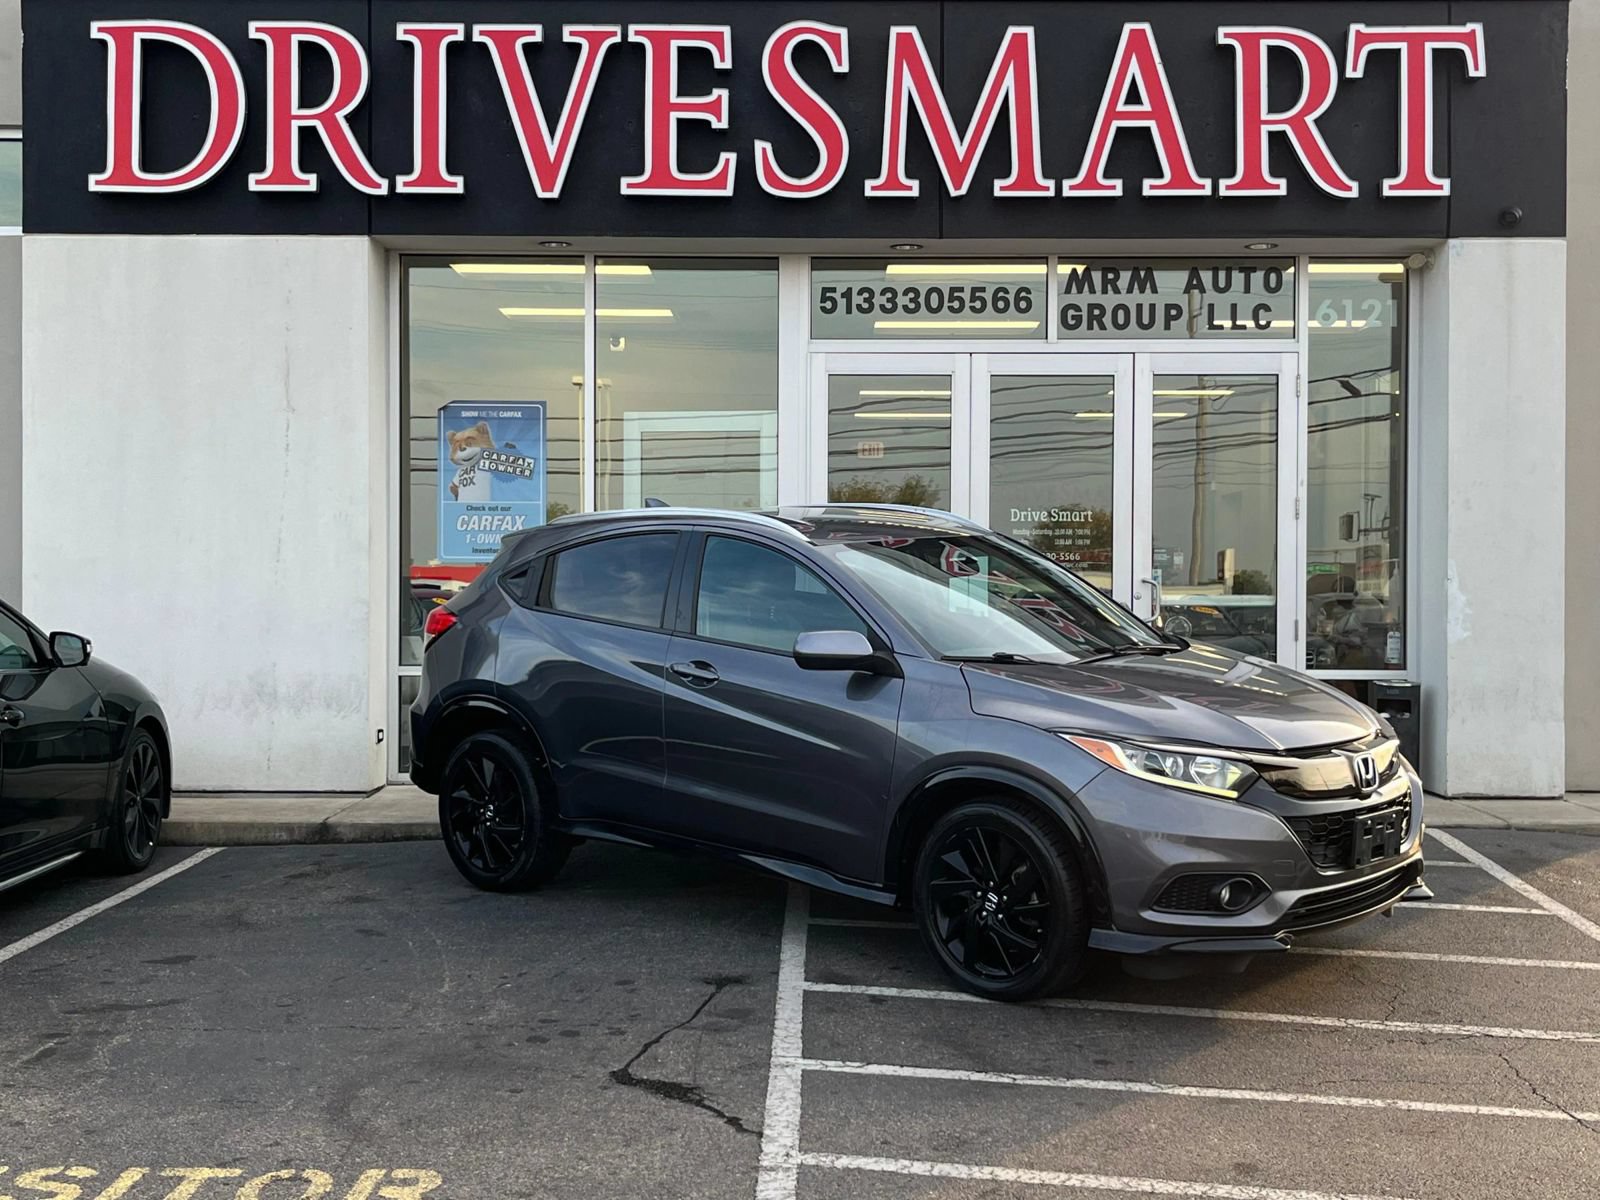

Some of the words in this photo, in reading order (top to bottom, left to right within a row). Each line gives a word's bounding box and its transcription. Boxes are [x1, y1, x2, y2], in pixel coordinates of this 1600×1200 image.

[88, 20, 1487, 200] DRIVESMART
[1064, 267, 1158, 295] MRM
[1183, 267, 1283, 295] AUTO
[819, 286, 1034, 316] 5133305566
[1060, 302, 1184, 331] GROUP
[1207, 302, 1273, 331] LLC
[1315, 299, 1397, 328] 6121
[482, 450, 534, 469] CARFAX
[490, 463, 532, 477] OWNER
[459, 476, 476, 487] FOX
[457, 515, 526, 531] CARFAX
[1010, 508, 1048, 522] Drive
[1050, 508, 1093, 522] Smart
[465, 533, 502, 544] 1-OWN
